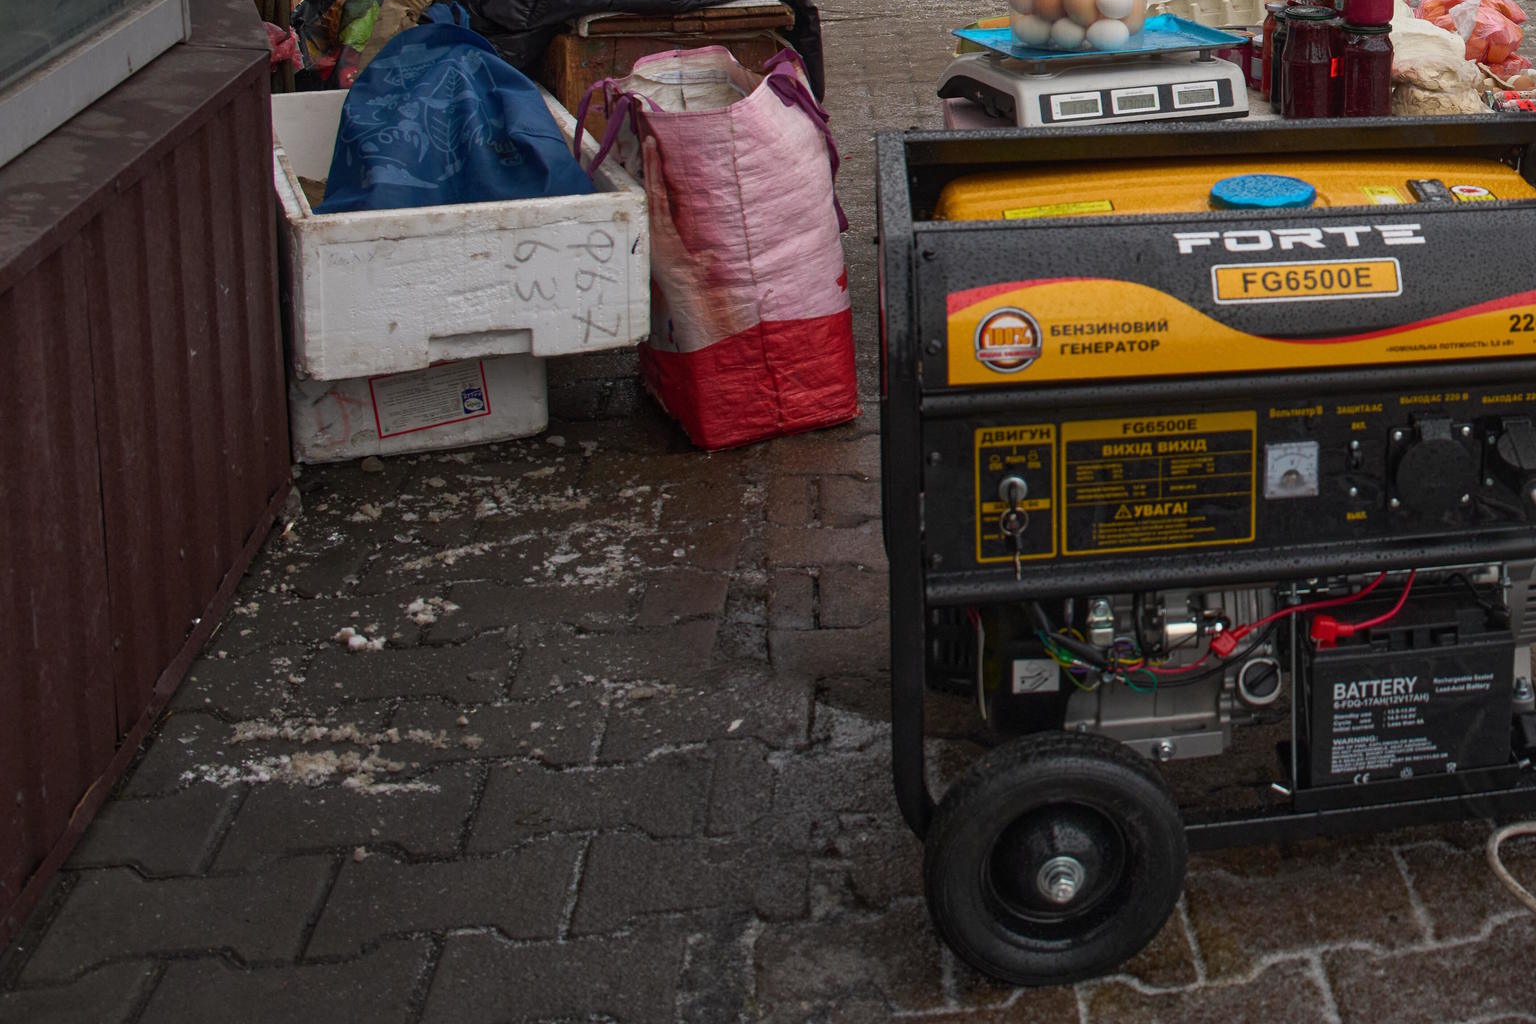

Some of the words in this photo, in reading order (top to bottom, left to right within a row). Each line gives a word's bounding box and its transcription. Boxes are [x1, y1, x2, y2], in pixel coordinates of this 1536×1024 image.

[1173, 223, 1426, 254] FORTE
[1242, 266, 1372, 293] FG6500E
[1050, 318, 1169, 337] БЕНЗИНОВИЙ
[1060, 339, 1160, 355] ГЕНЕРАТОР
[1122, 419, 1197, 434] FG6500E
[981, 428, 1051, 445] ДВИГУН
[1102, 443, 1153, 458] ВИХІД
[1157, 438, 1208, 454] ВИХІД
[1134, 501, 1188, 517] УВАГА!
[1333, 676, 1418, 701] BATTERY
[1333, 735, 1378, 746] WARNING:
